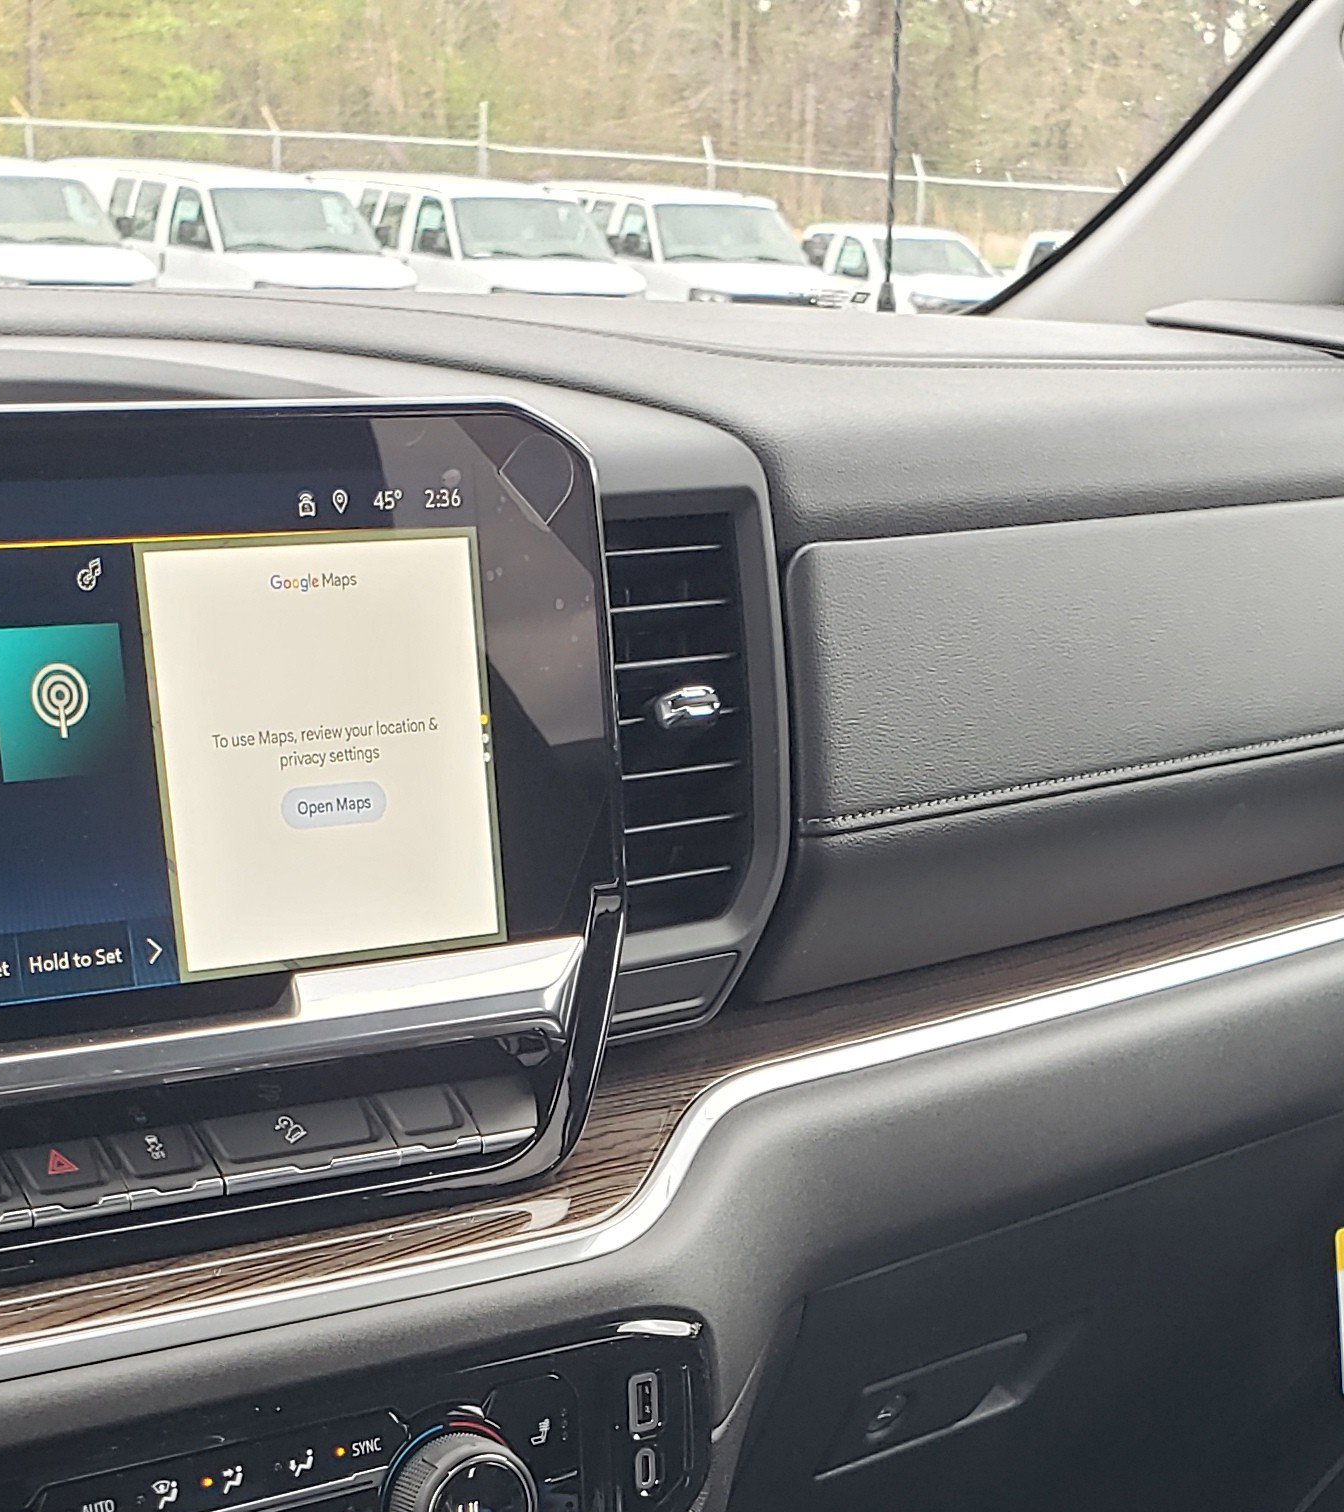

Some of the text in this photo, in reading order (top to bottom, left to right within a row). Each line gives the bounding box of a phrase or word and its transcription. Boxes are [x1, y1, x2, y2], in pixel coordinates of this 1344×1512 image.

[424, 488, 461, 509] 2:36
[269, 572, 357, 592] Google Maps
[212, 717, 438, 748] To use Maps, review your location &
[279, 746, 380, 770] privacy settings
[297, 797, 372, 817] Open Maps
[29, 948, 123, 974] Hold to Set
[352, 1437, 382, 1457] SYNC
